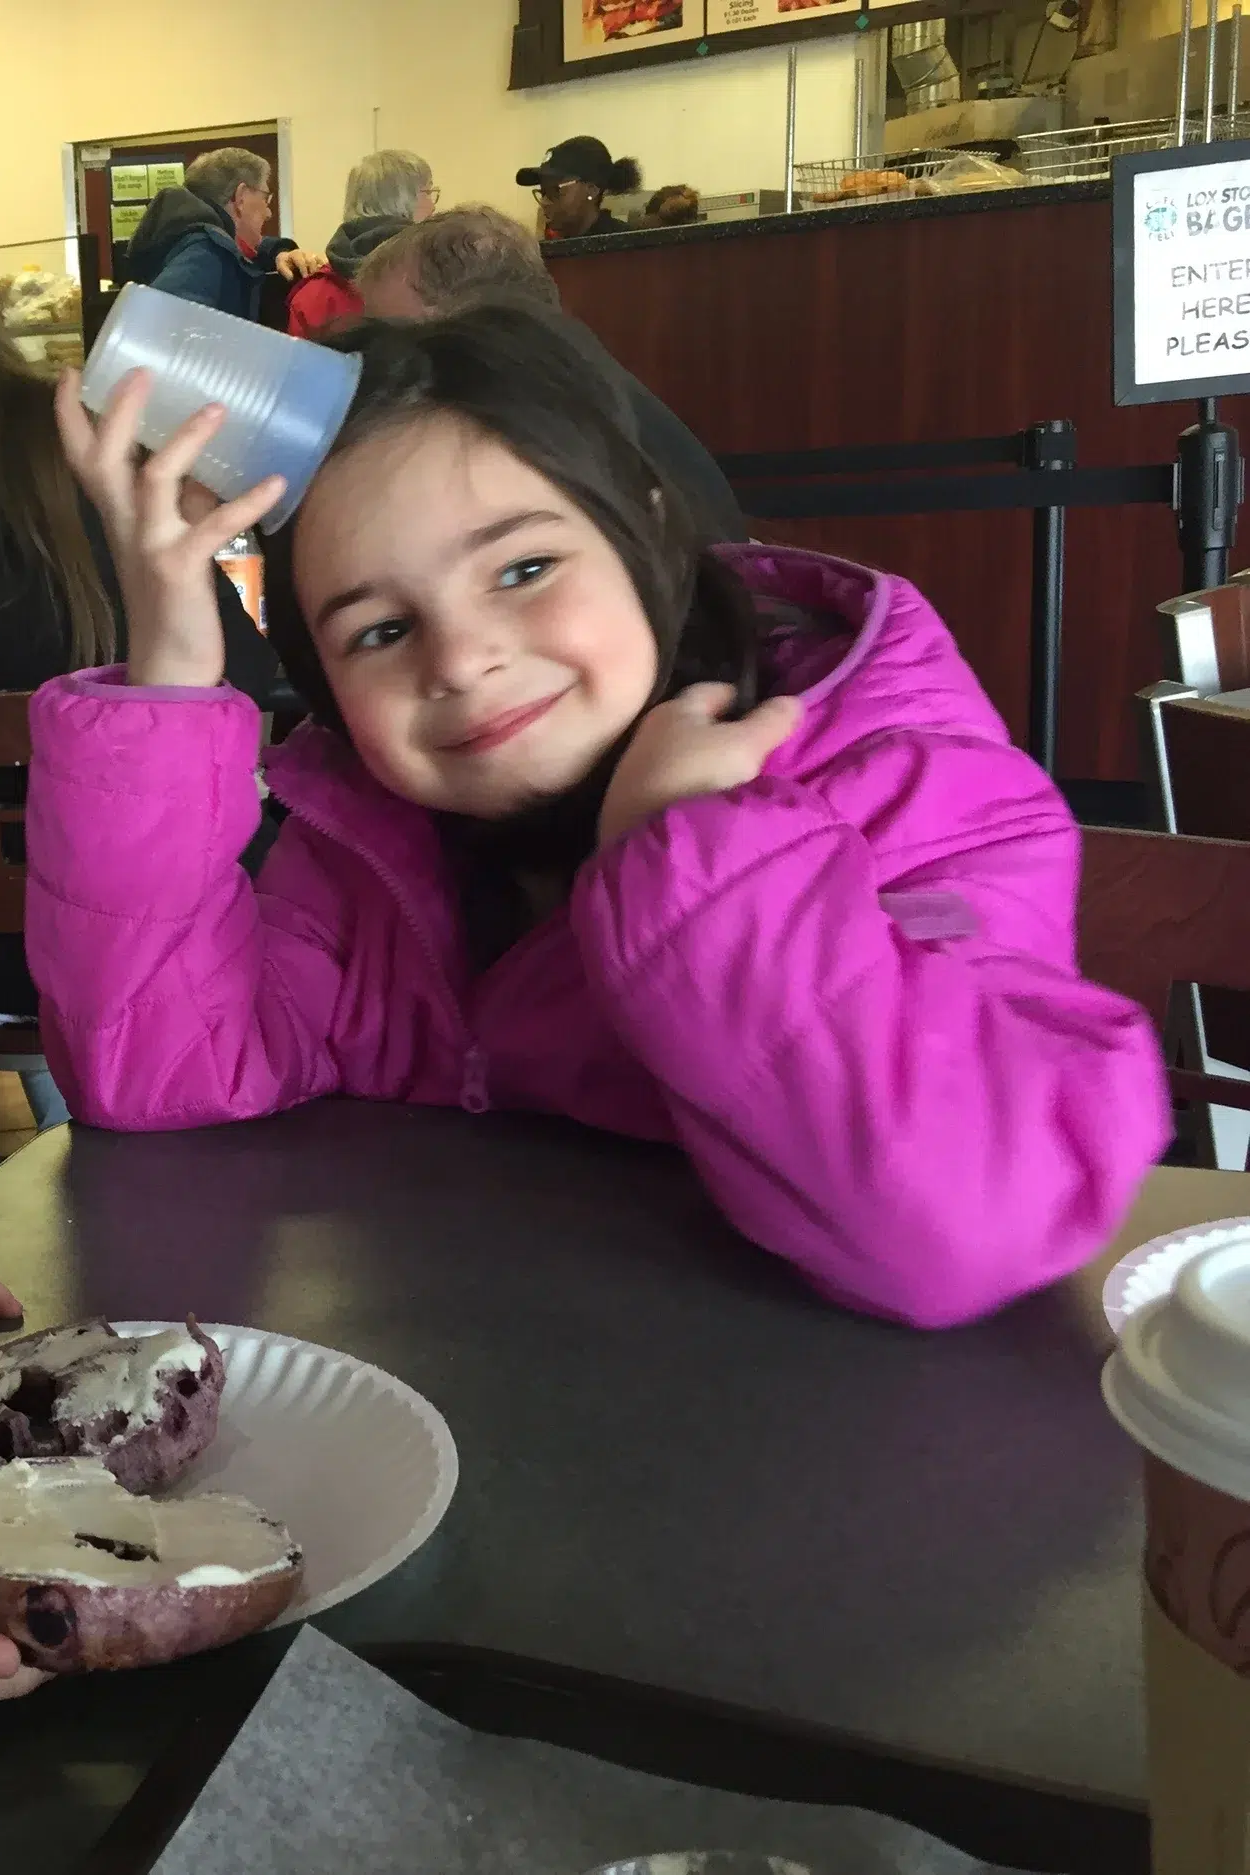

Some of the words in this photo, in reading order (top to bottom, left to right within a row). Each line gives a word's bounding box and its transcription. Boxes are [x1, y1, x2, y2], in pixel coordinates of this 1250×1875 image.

[1186, 190, 1218, 208] LOX
[1220, 186, 1250, 204] STO
[1181, 292, 1250, 320] HERE
[1166, 329, 1250, 356] PLEAS
